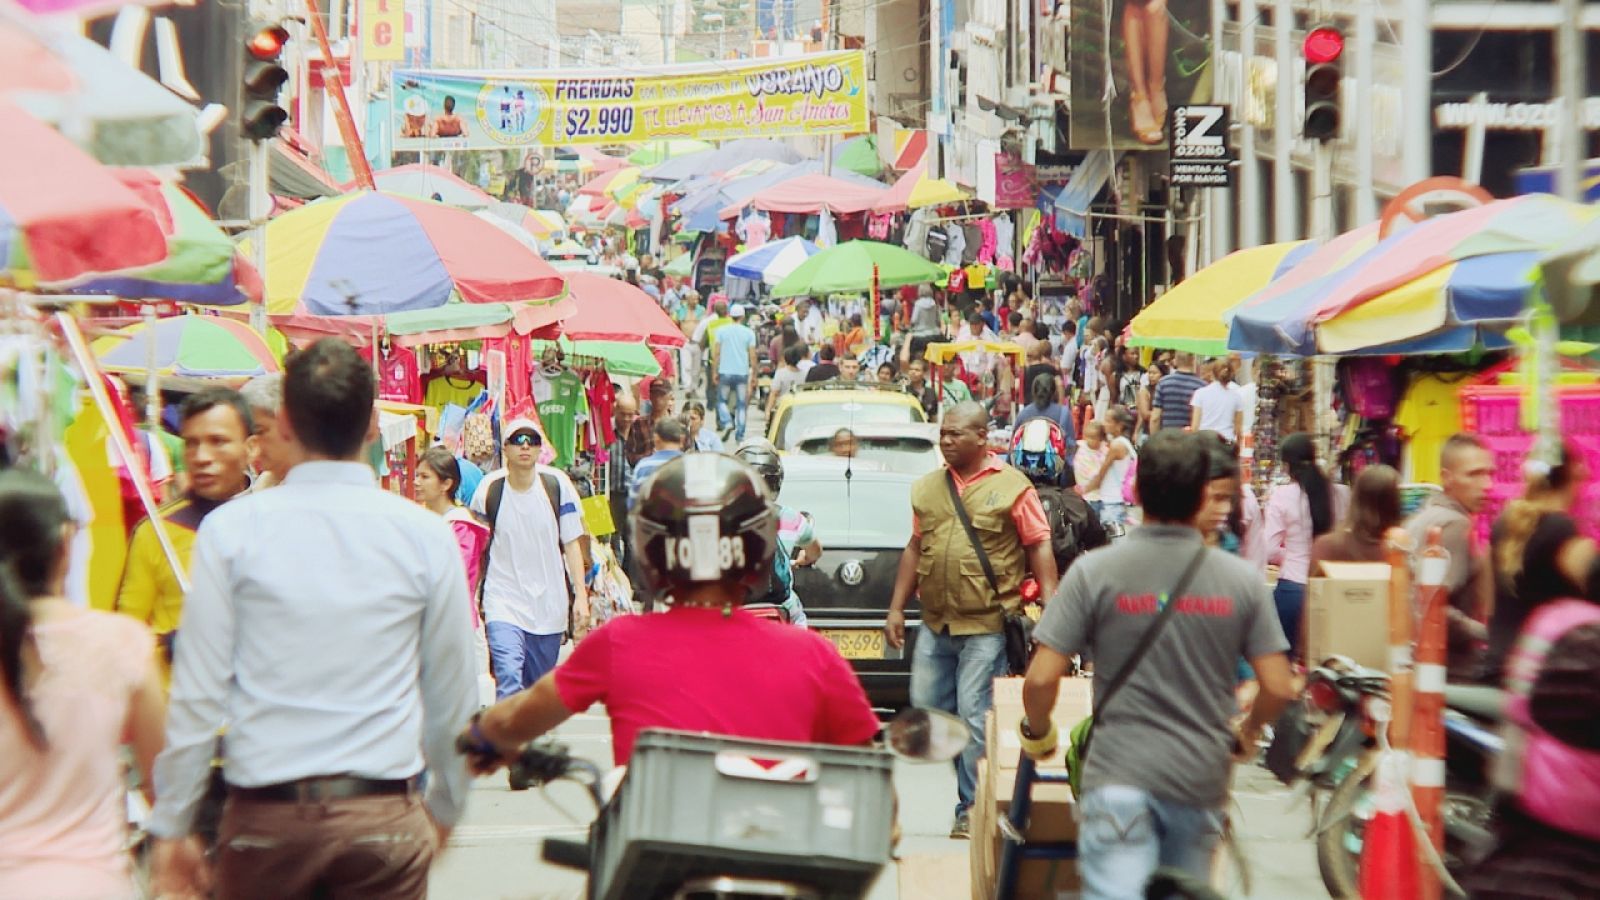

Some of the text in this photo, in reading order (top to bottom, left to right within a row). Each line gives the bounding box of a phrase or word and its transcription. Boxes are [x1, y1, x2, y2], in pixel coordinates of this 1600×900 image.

[555, 79, 635, 100] PRENDAS
[565, 106, 633, 139] $2.990
[665, 104, 732, 126] LLEVAMOS
[746, 98, 784, 125] San
[1186, 106, 1224, 146] Z
[1175, 145, 1225, 156] OZONO
[1172, 174, 1228, 183] POR MAYOR
[1174, 164, 1227, 174] VENTAS AL
